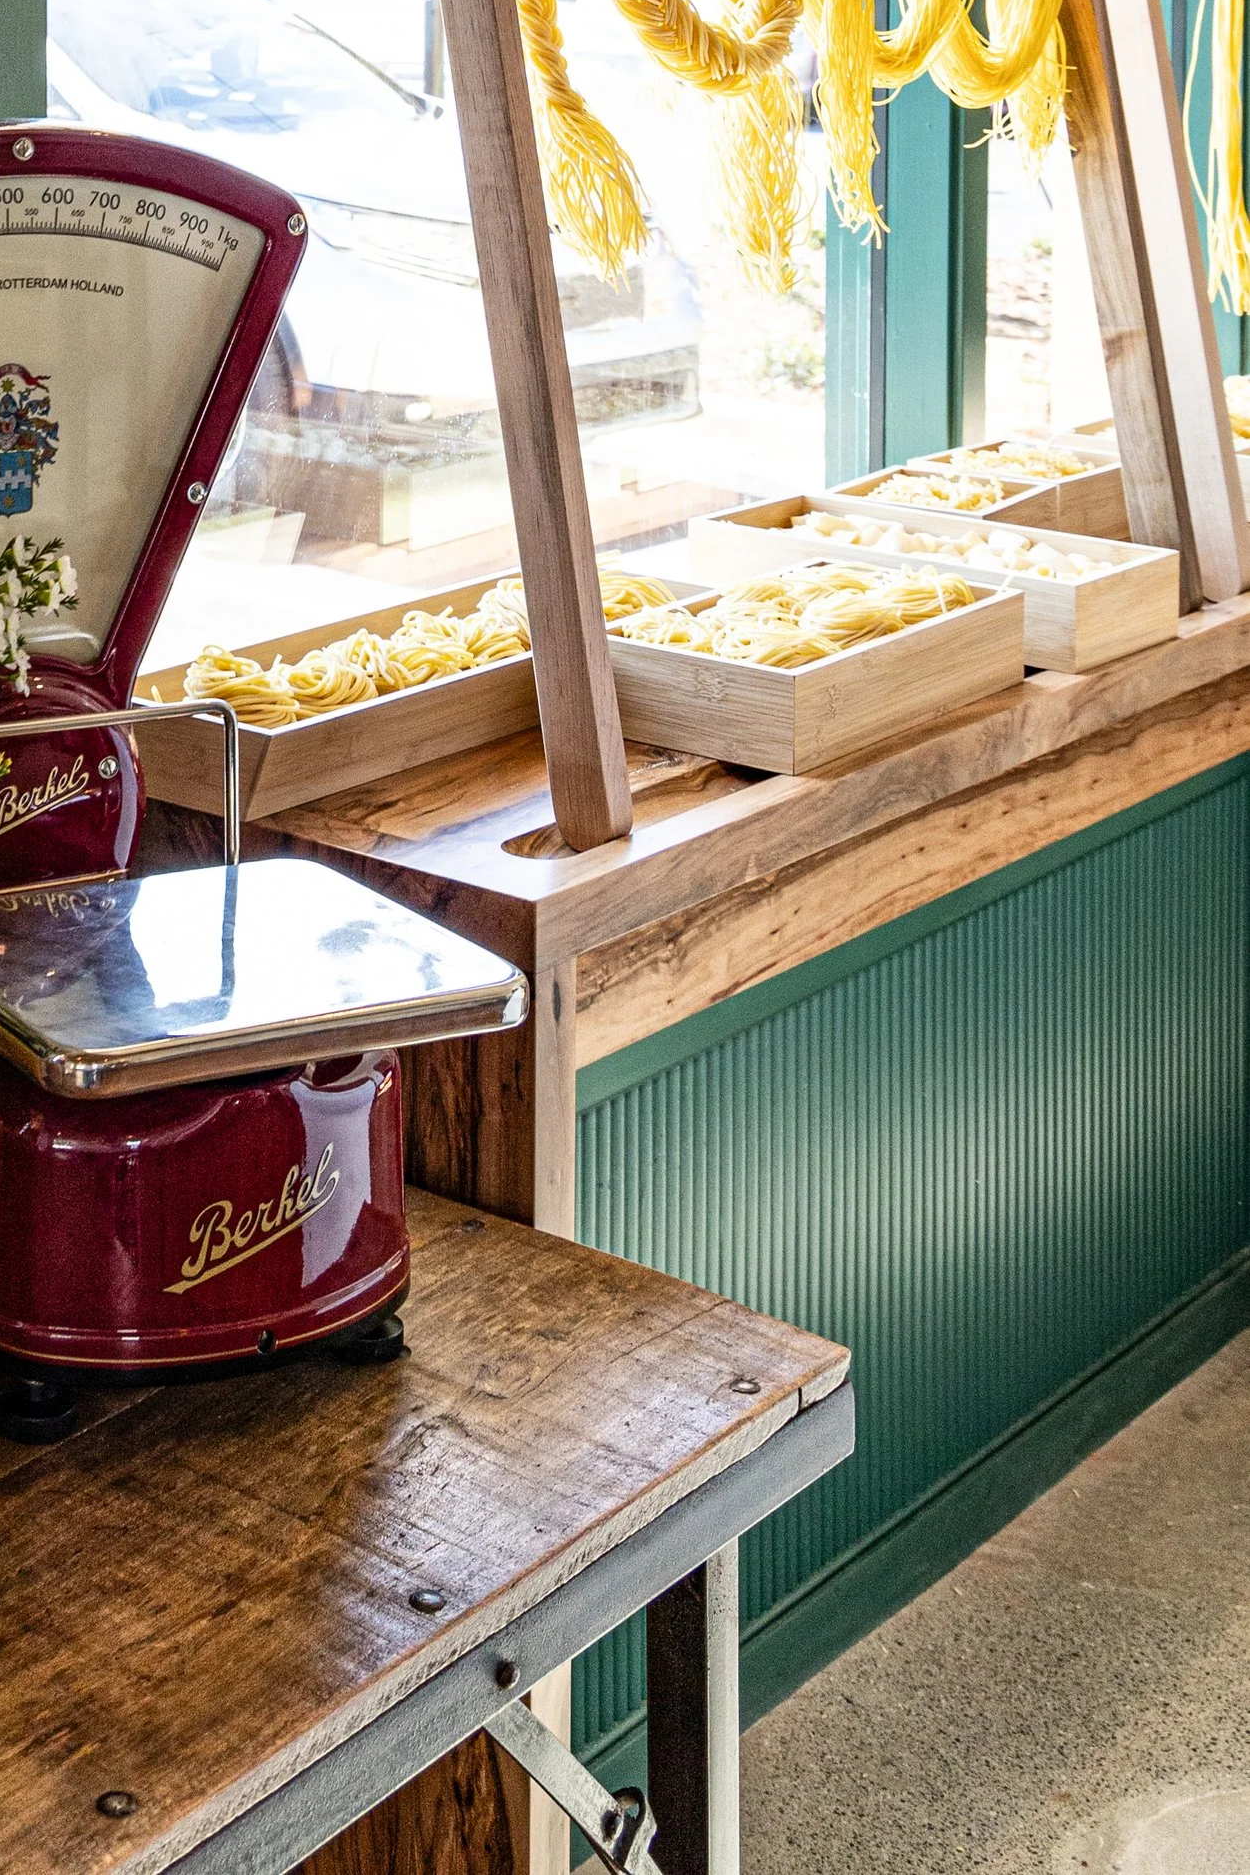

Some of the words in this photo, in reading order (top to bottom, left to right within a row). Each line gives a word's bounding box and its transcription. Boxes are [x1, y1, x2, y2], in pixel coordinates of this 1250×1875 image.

[24, 207, 39, 216] 550
[71, 209, 85, 217] 650
[118, 215, 132, 225] 750
[201, 238, 214, 249] 950
[41, 187, 74, 205] 600
[89, 191, 121, 210] 700
[135, 199, 166, 220] 800
[180, 212, 209, 234] 900
[70, 278, 124, 297] HOLLAND
[162, 1142, 339, 1294] Berkel
